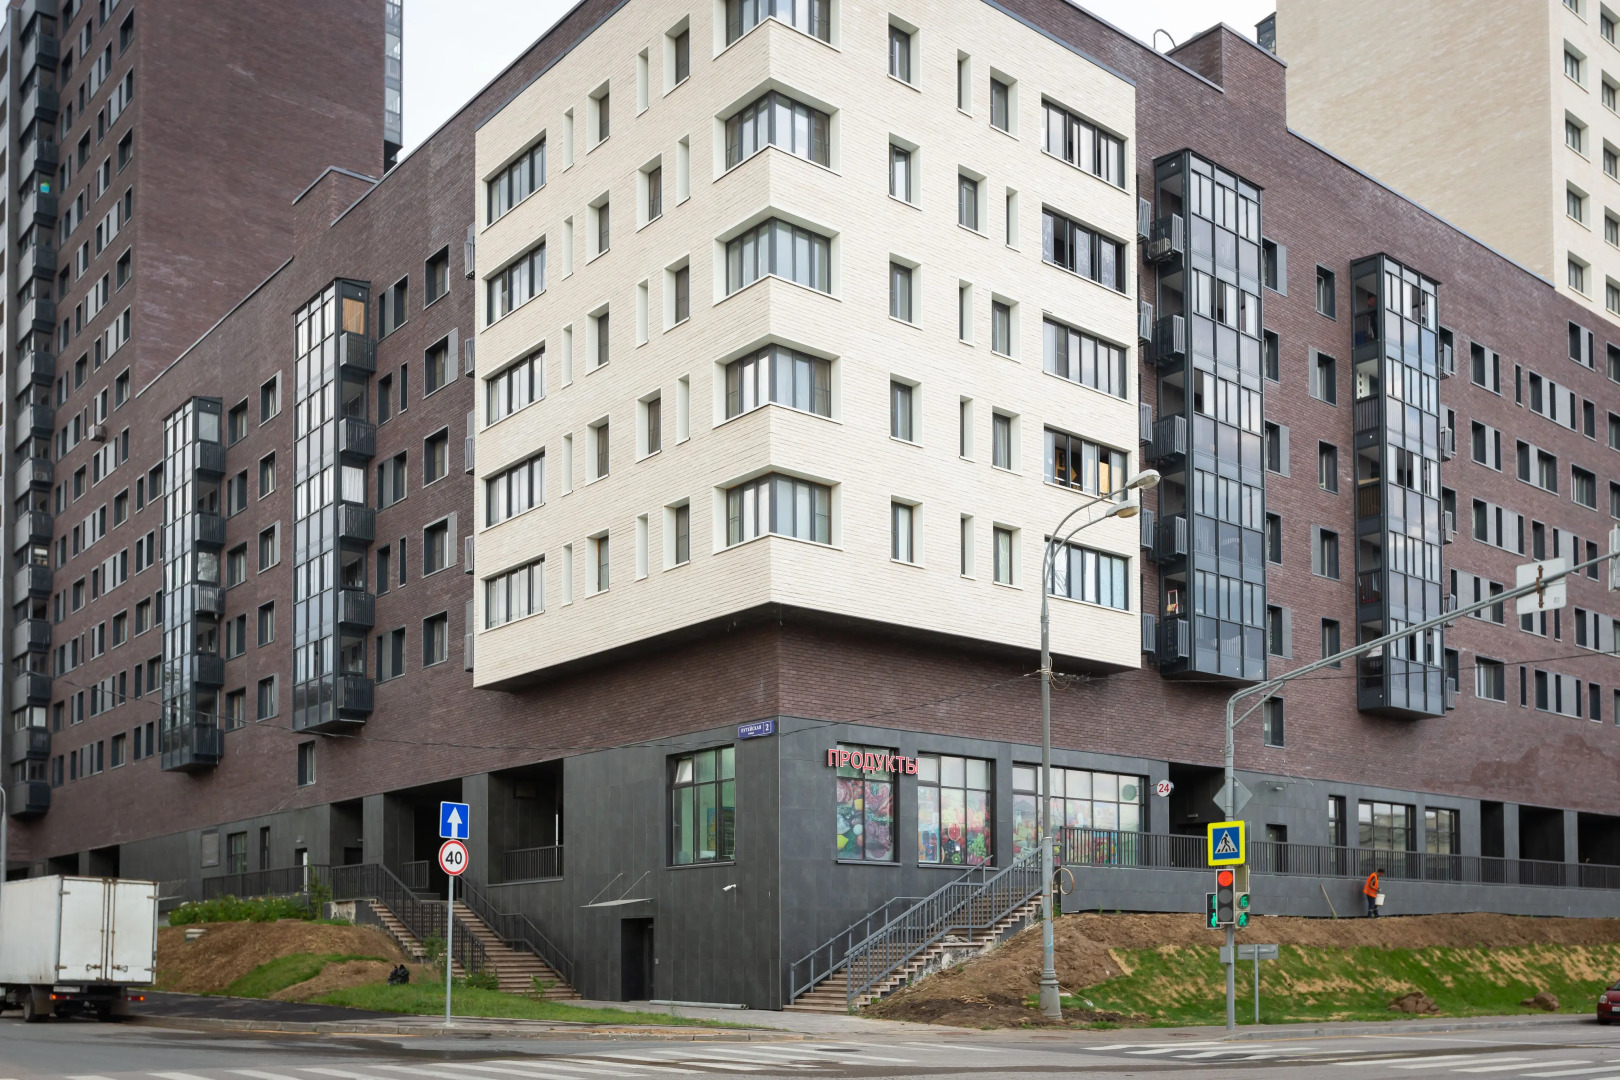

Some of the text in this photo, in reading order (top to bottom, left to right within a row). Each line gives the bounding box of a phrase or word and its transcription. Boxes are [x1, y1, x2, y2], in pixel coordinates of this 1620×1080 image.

[828, 749, 919, 774] ПРОДУКТЫ
[1158, 783, 1170, 793] 24
[445, 850, 463, 865] 40
